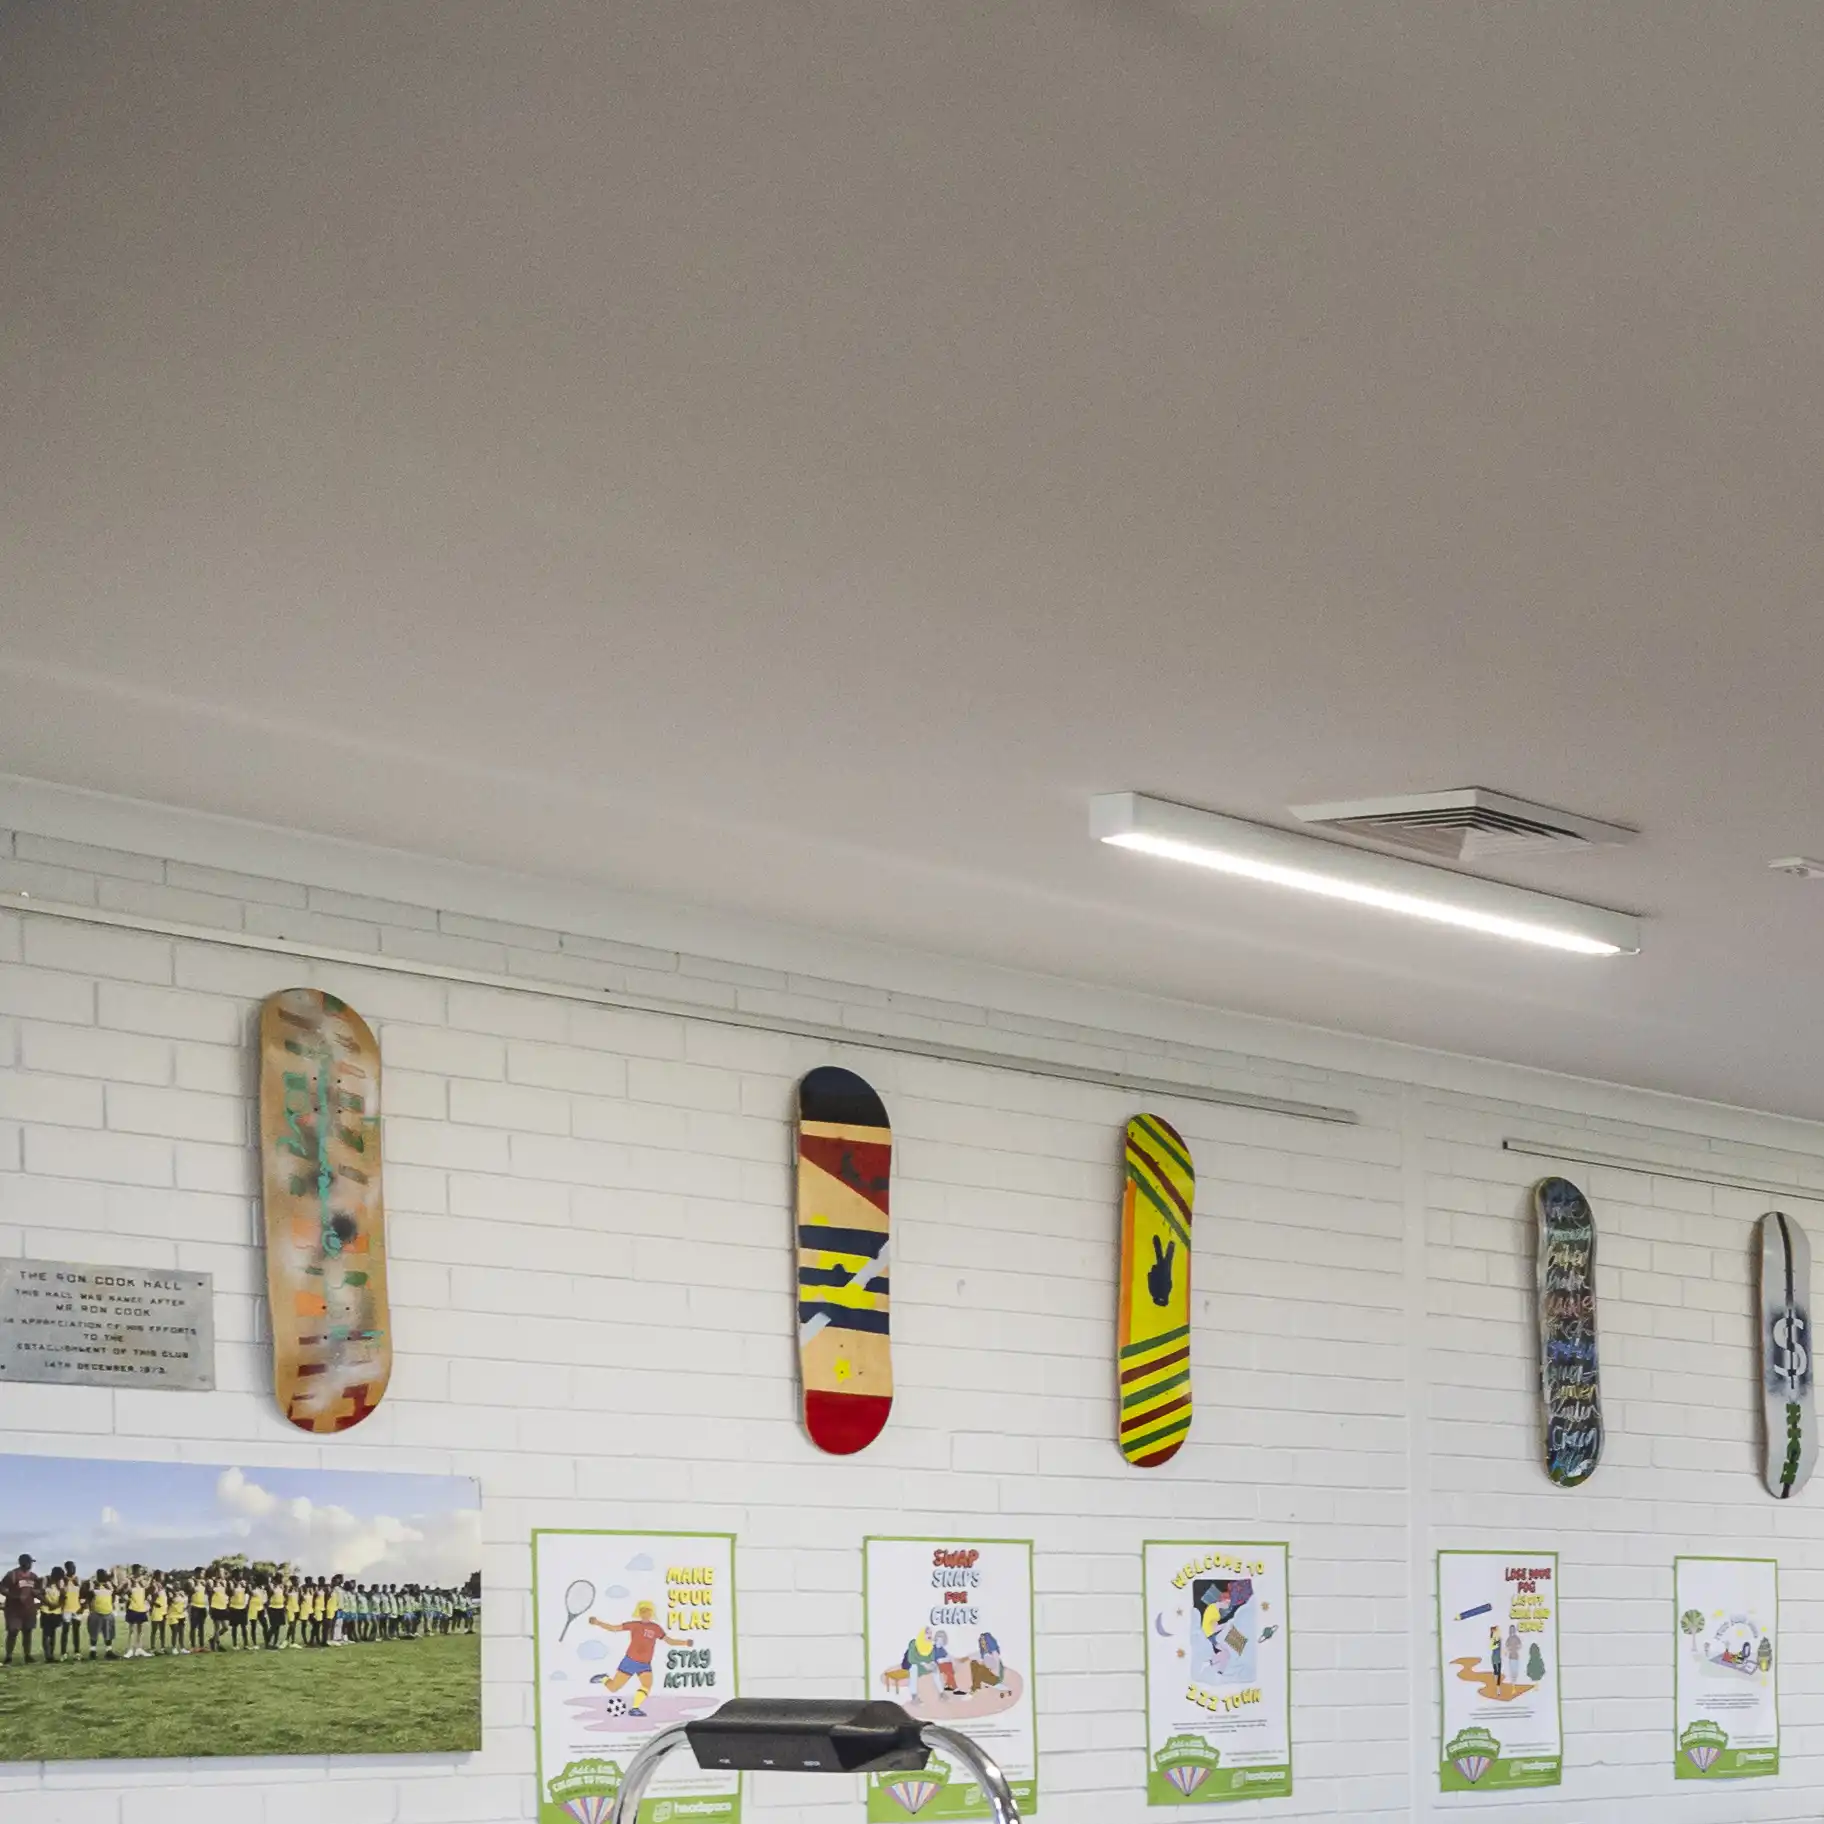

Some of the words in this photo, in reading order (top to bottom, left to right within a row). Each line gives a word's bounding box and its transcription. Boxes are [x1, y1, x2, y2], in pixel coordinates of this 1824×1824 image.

[20, 1271, 47, 1282] THE
[56, 1273, 87, 1284] RON
[94, 1276, 136, 1288] COOK
[143, 1280, 182, 1291] HALL
[15, 1288, 39, 1297] THIS
[80, 1293, 102, 1301] WAS
[150, 1297, 186, 1307] AFTER
[81, 1305, 108, 1314] RON
[115, 1307, 152, 1317] COOK
[21, 1317, 102, 1330] APPRECIATION
[148, 1325, 198, 1336] EFFORTS
[83, 1333, 98, 1342] TO
[104, 1334, 125, 1343] THE
[16, 1342, 107, 1355] ESTABLISHMENT
[113, 1347, 128, 1356] OF
[133, 1348, 158, 1357] THIS
[161, 1350, 190, 1360] CLUB
[932, 1548, 980, 1569] SWAP
[665, 1566, 715, 1586] MAKE
[931, 1570, 981, 1589] SNAPS
[1171, 1552, 1243, 1590] WELCOME
[1246, 1560, 1266, 1577] TO
[667, 1589, 713, 1608] YOUR
[944, 1591, 969, 1605] FOR
[667, 1611, 713, 1631] PLAY
[929, 1607, 980, 1626] CHATS
[666, 1648, 711, 1670] STAY
[663, 1671, 716, 1689] ACTIVE
[1185, 1684, 1219, 1712] ZZZ
[1220, 1688, 1262, 1712] TOWN
